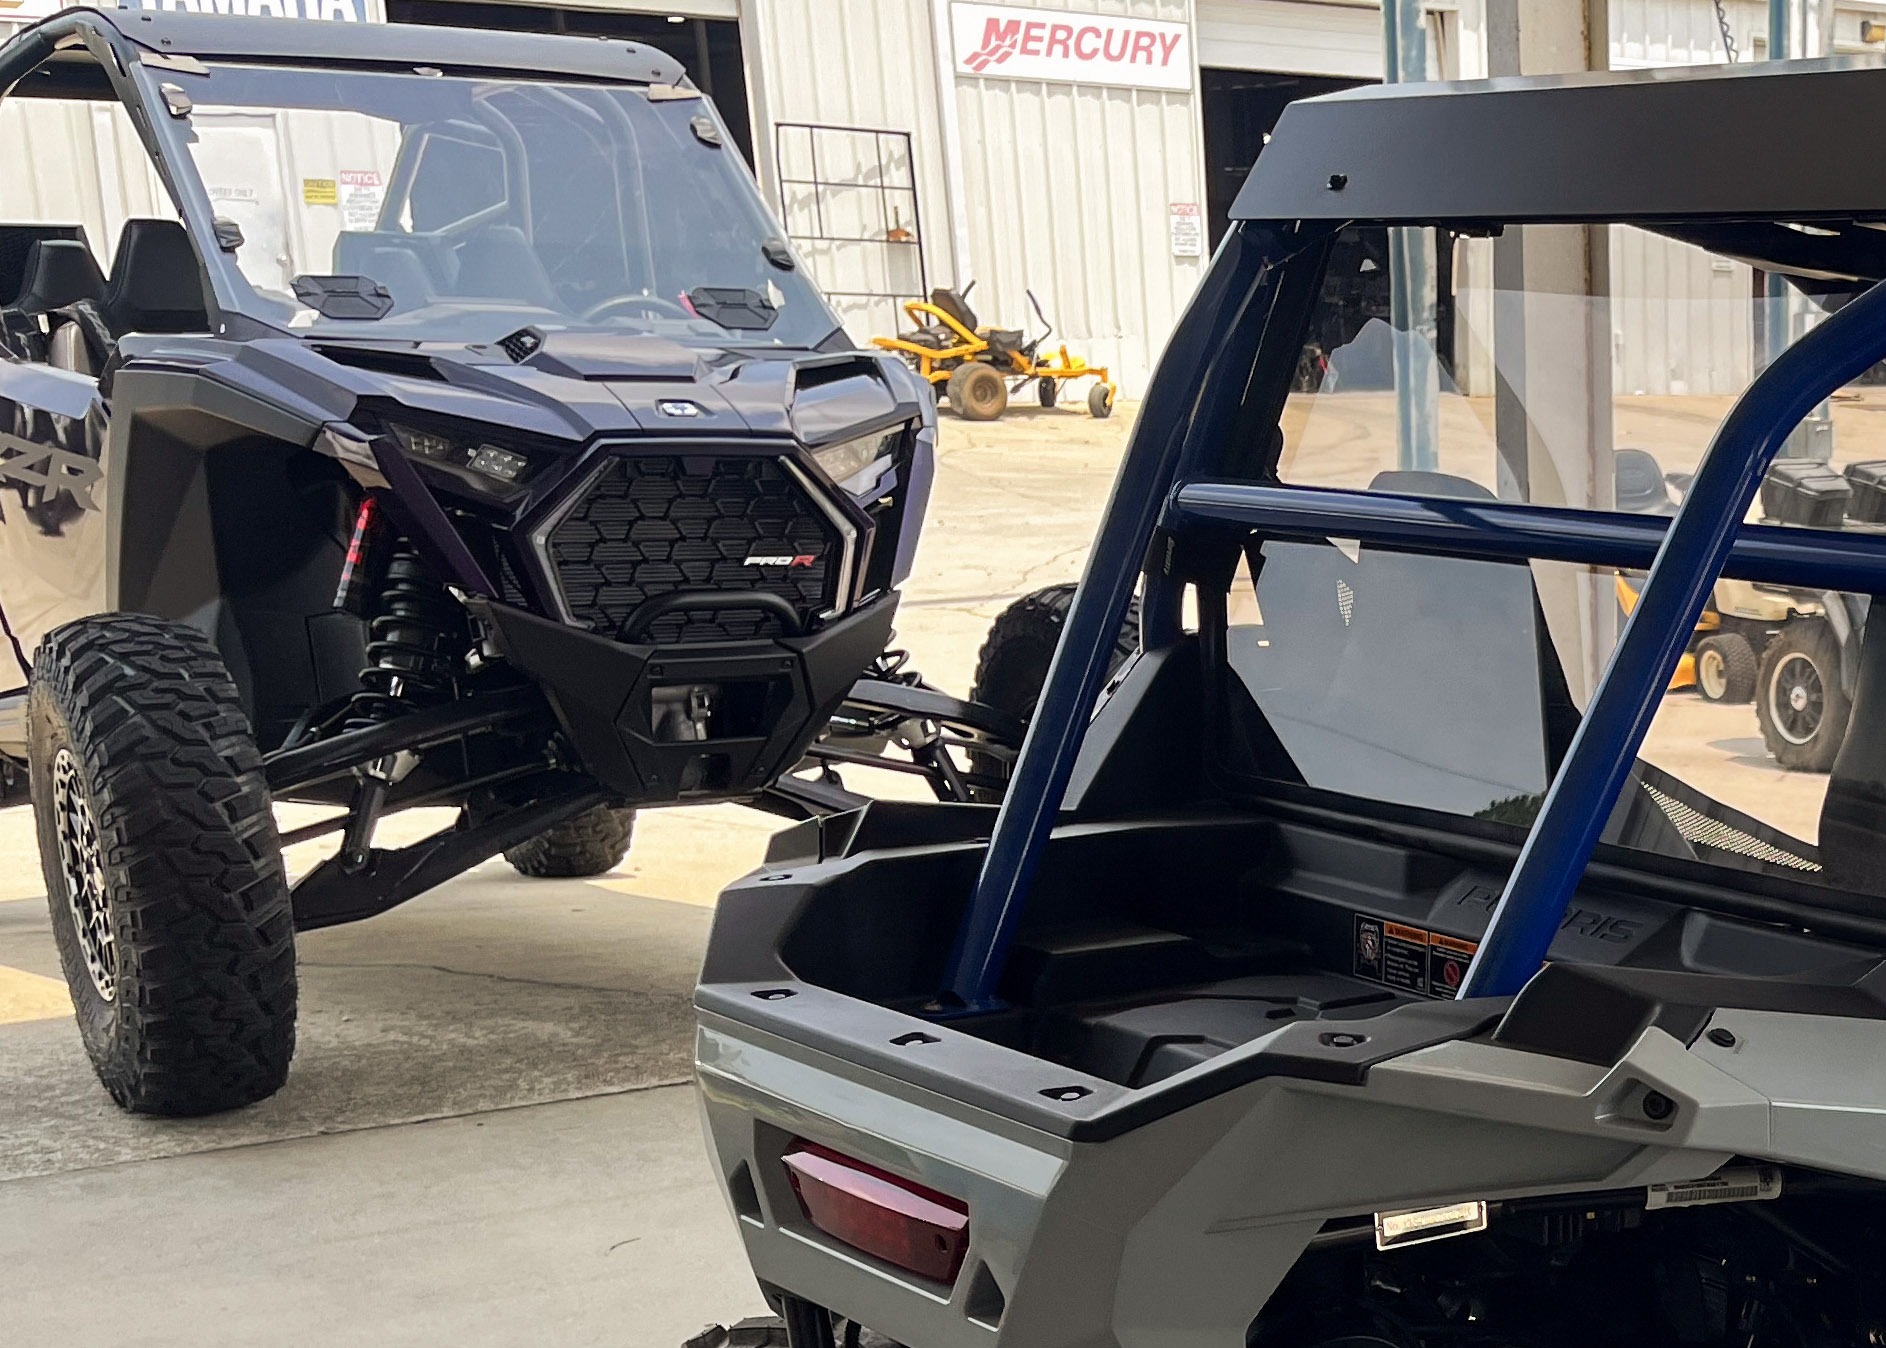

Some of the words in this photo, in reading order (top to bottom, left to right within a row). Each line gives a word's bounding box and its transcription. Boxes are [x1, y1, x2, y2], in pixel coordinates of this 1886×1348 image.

[963, 18, 1182, 72] MERCURY
[0, 431, 104, 512] ZR
[1457, 885, 1643, 944] PRIS
